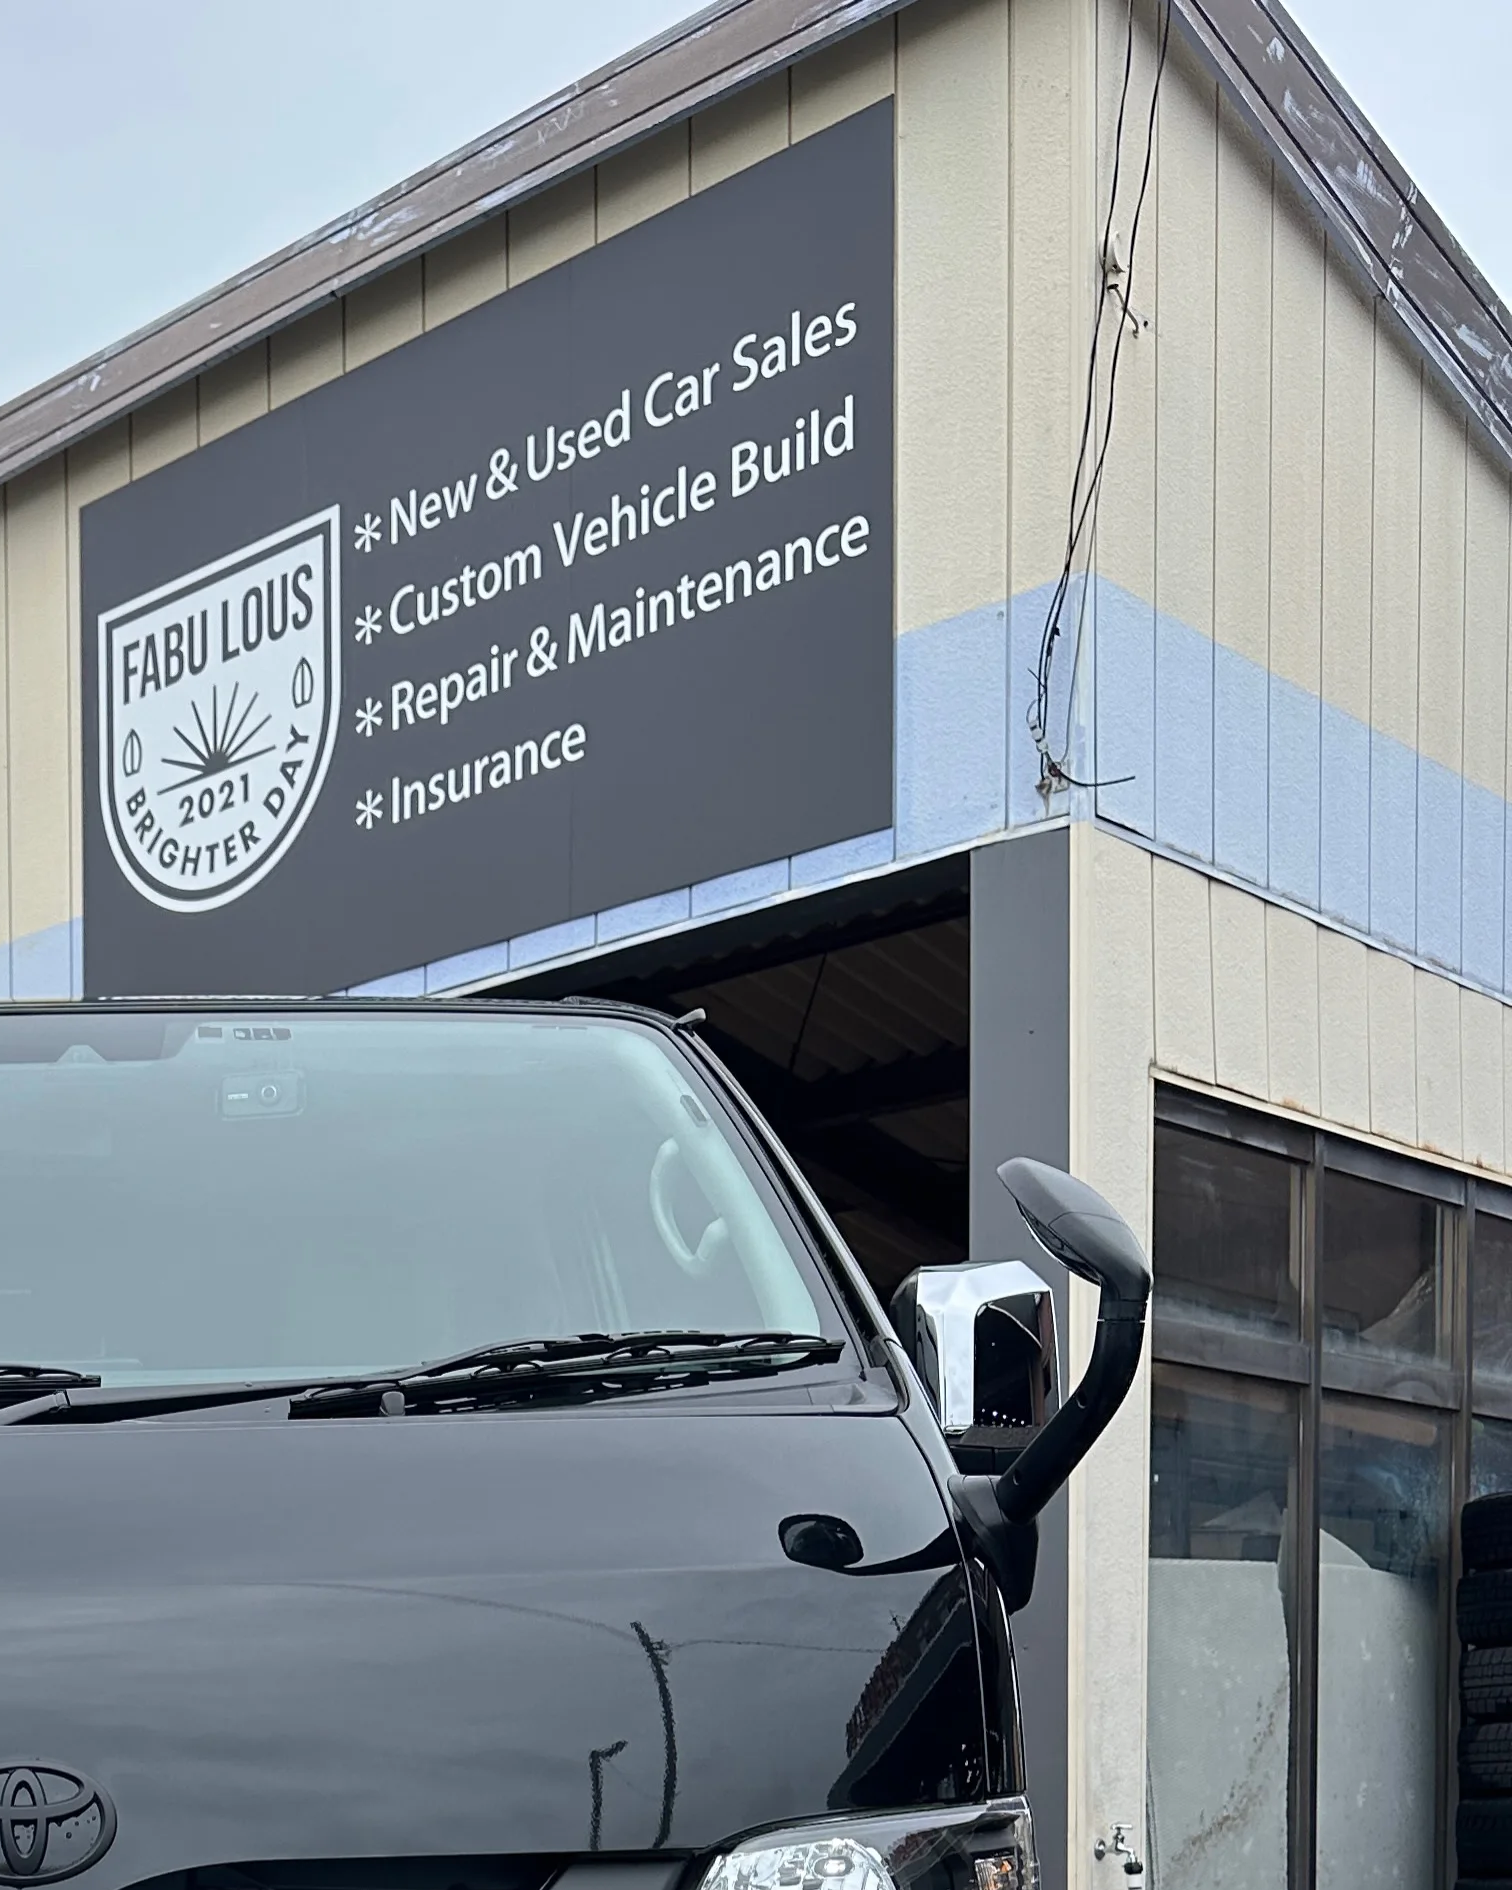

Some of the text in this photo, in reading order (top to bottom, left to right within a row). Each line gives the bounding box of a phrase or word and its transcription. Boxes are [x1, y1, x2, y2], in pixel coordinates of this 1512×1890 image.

[389, 394, 854, 635] Custom Vehicle Build
[390, 302, 858, 545] New & Used Car Sales
[391, 515, 870, 731] Repair & Maintenance
[125, 724, 311, 877] BRIGHTER DAY
[178, 773, 250, 828] 2021
[392, 723, 586, 824] Insurance
